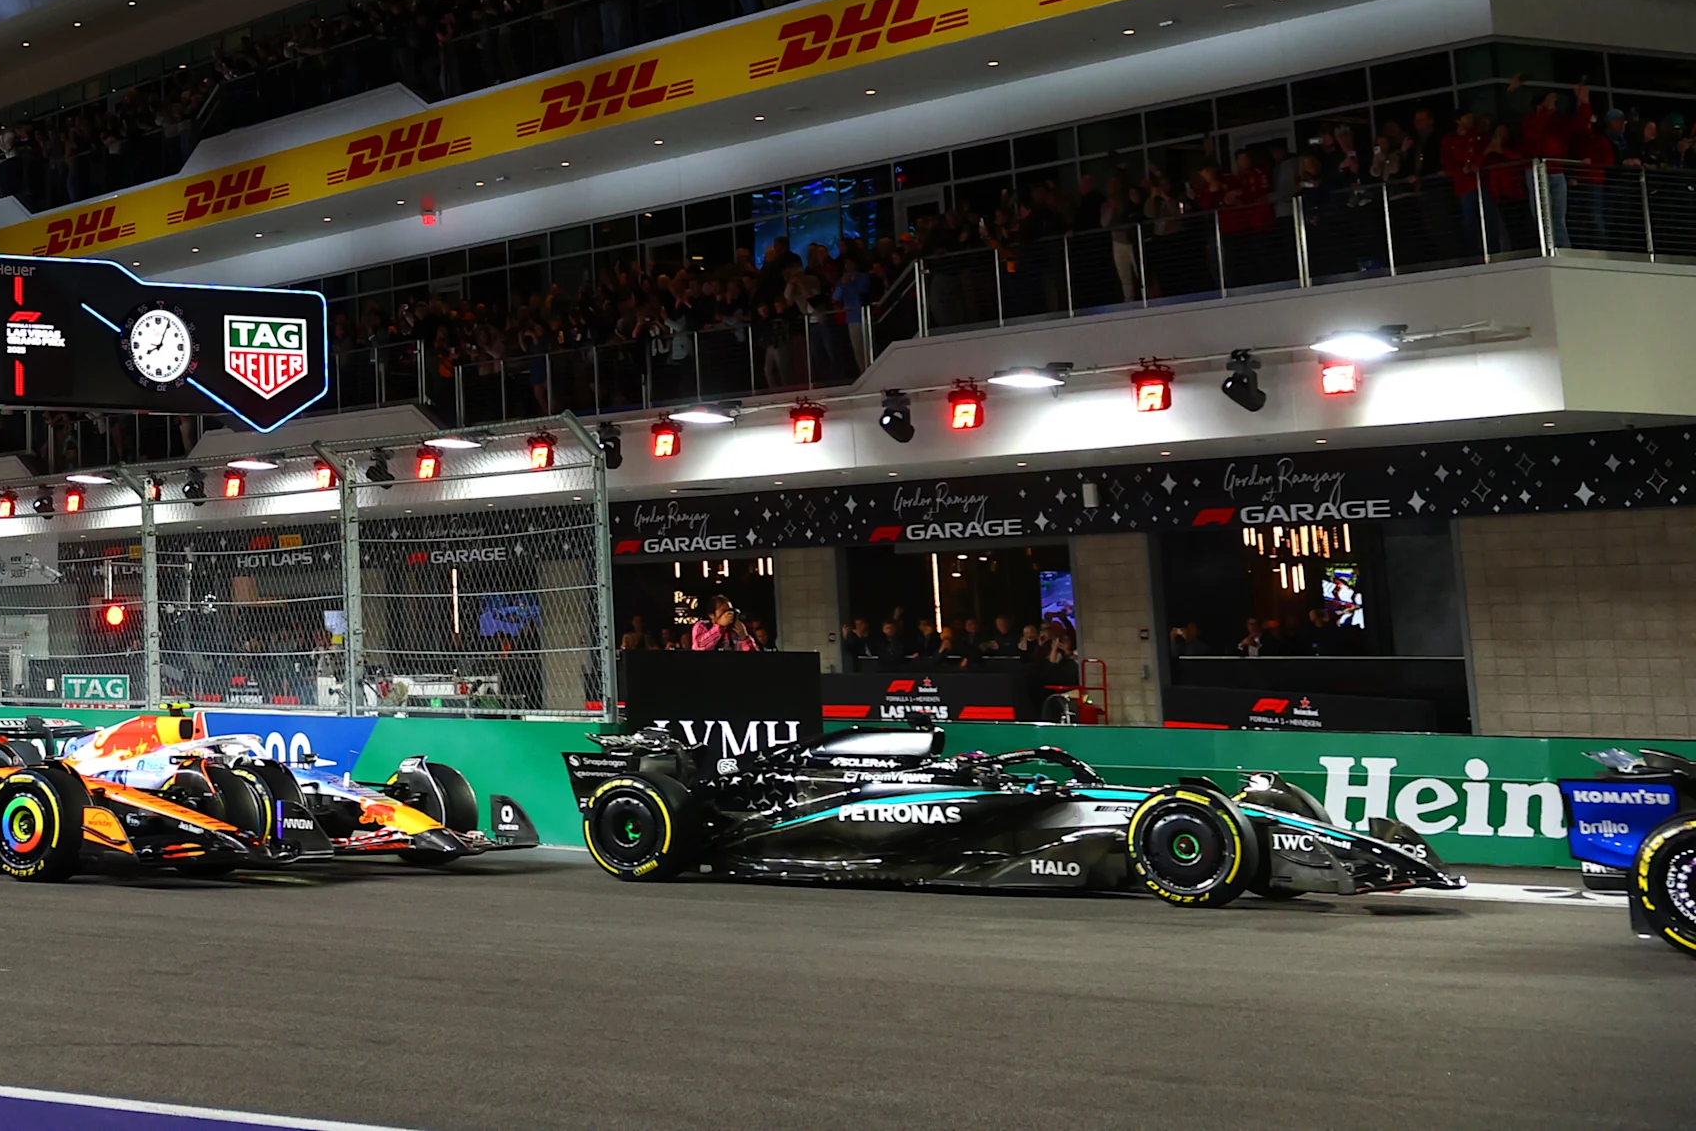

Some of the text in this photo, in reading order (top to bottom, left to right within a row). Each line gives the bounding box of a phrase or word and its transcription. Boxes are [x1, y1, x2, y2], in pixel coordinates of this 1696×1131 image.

[538, 59, 671, 133] DHL
[346, 118, 453, 181] DHL
[182, 166, 272, 223] DHL
[44, 206, 122, 256] DHL
[7, 328, 61, 339] LAS VEGAS
[7, 337, 66, 347] GRAND PRIX
[231, 322, 300, 348] TAG
[230, 353, 303, 391] HEUER
[1240, 499, 1392, 523] GARAGE
[906, 519, 1022, 540] GARAGE
[644, 535, 736, 553] GARAGE
[236, 551, 313, 568] HOT LAPS
[430, 547, 506, 564] GARAGE
[68, 679, 124, 698] TAG
[880, 705, 904, 718] LAS
[1249, 715, 1279, 724] FORMULA
[1289, 719, 1322, 727] HEINEKEN
[582, 757, 627, 768] Snapdragon
[840, 758, 888, 768] SOLERA
[859, 771, 935, 784] TeamViewer
[1573, 789, 1671, 805] KOMATSU
[838, 804, 962, 823] PETRONAS
[88, 819, 113, 828] workday
[1579, 820, 1629, 835] brillio
[1272, 833, 1314, 852] IWC
[2, 859, 44, 877] P ZERO
[1030, 859, 1080, 875] HALO
[1666, 865, 1678, 889] CITY
[1146, 880, 1210, 903] P ZERO
